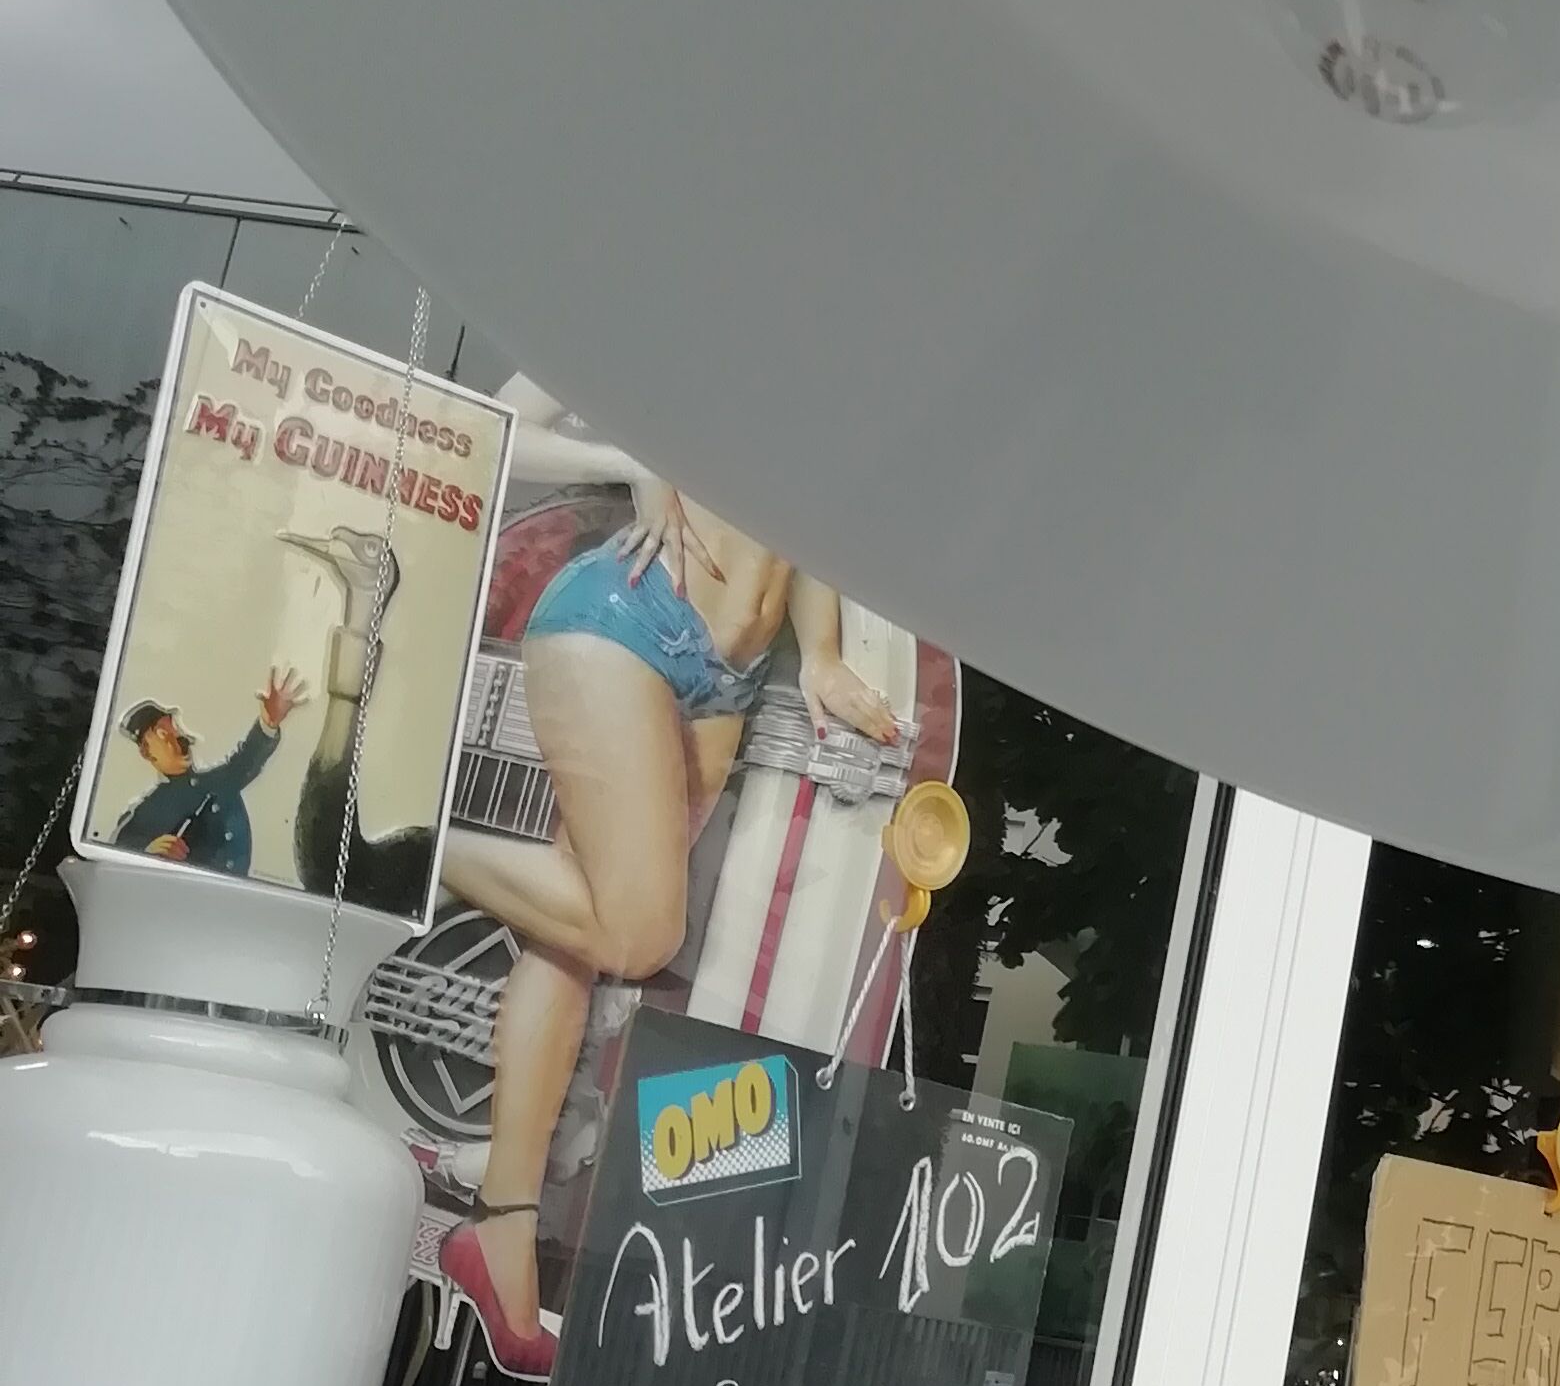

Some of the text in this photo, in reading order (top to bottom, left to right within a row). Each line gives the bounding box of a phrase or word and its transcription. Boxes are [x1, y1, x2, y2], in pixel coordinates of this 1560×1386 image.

[231, 337, 474, 459] My Goodness
[184, 396, 484, 532] My GUINNESS
[653, 1063, 775, 1181] OMO
[977, 1115, 1006, 1132] VENTE
[599, 1147, 1041, 1366] Atelier 102
